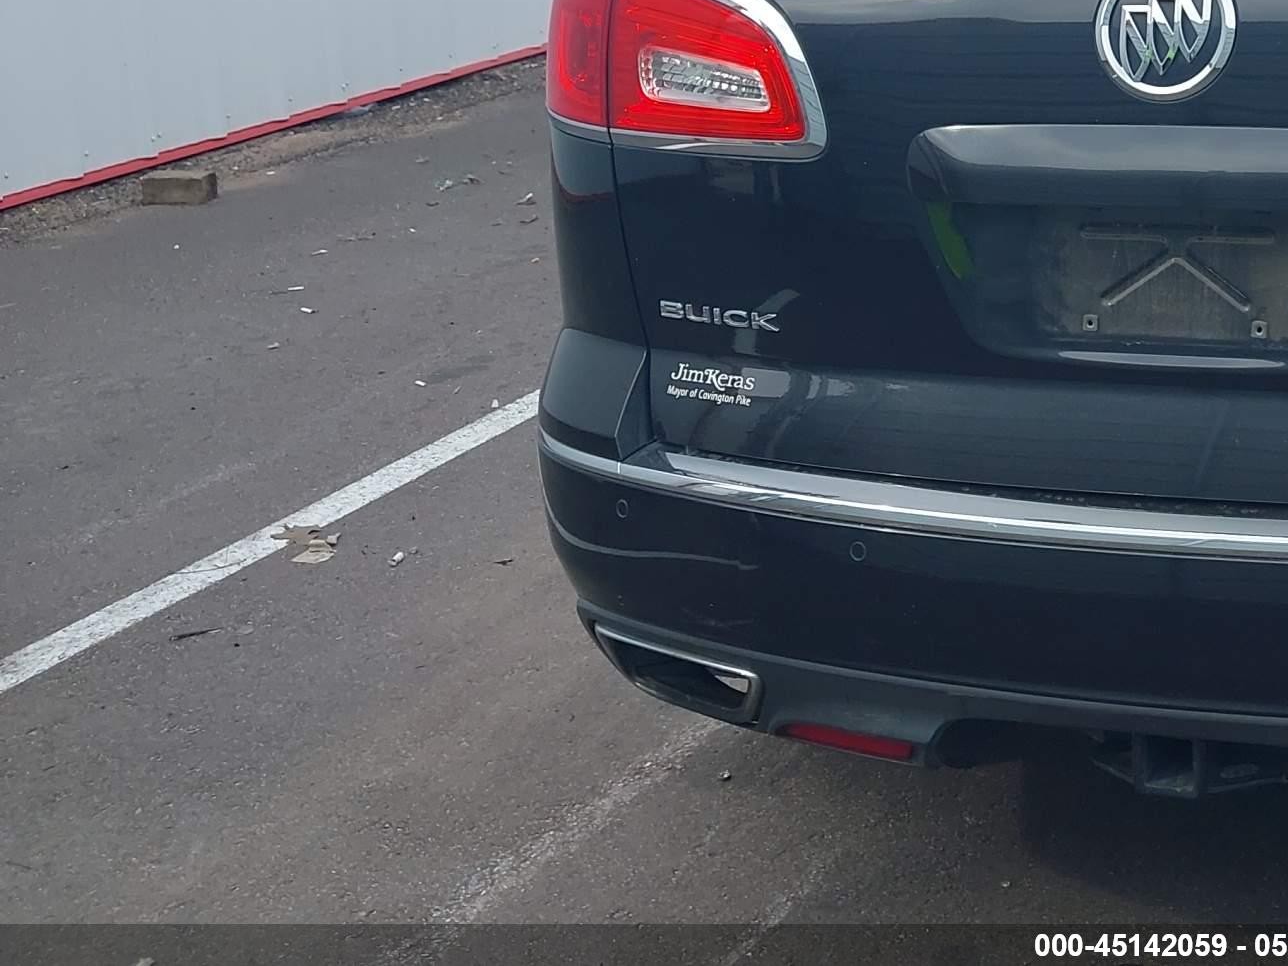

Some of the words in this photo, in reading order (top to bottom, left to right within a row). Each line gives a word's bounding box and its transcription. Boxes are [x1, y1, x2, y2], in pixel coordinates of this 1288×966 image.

[659, 299, 780, 332] BUICK
[667, 384, 689, 399] Mayor
[689, 388, 698, 398] of
[698, 389, 735, 405] Covington
[735, 394, 752, 407] Pike
